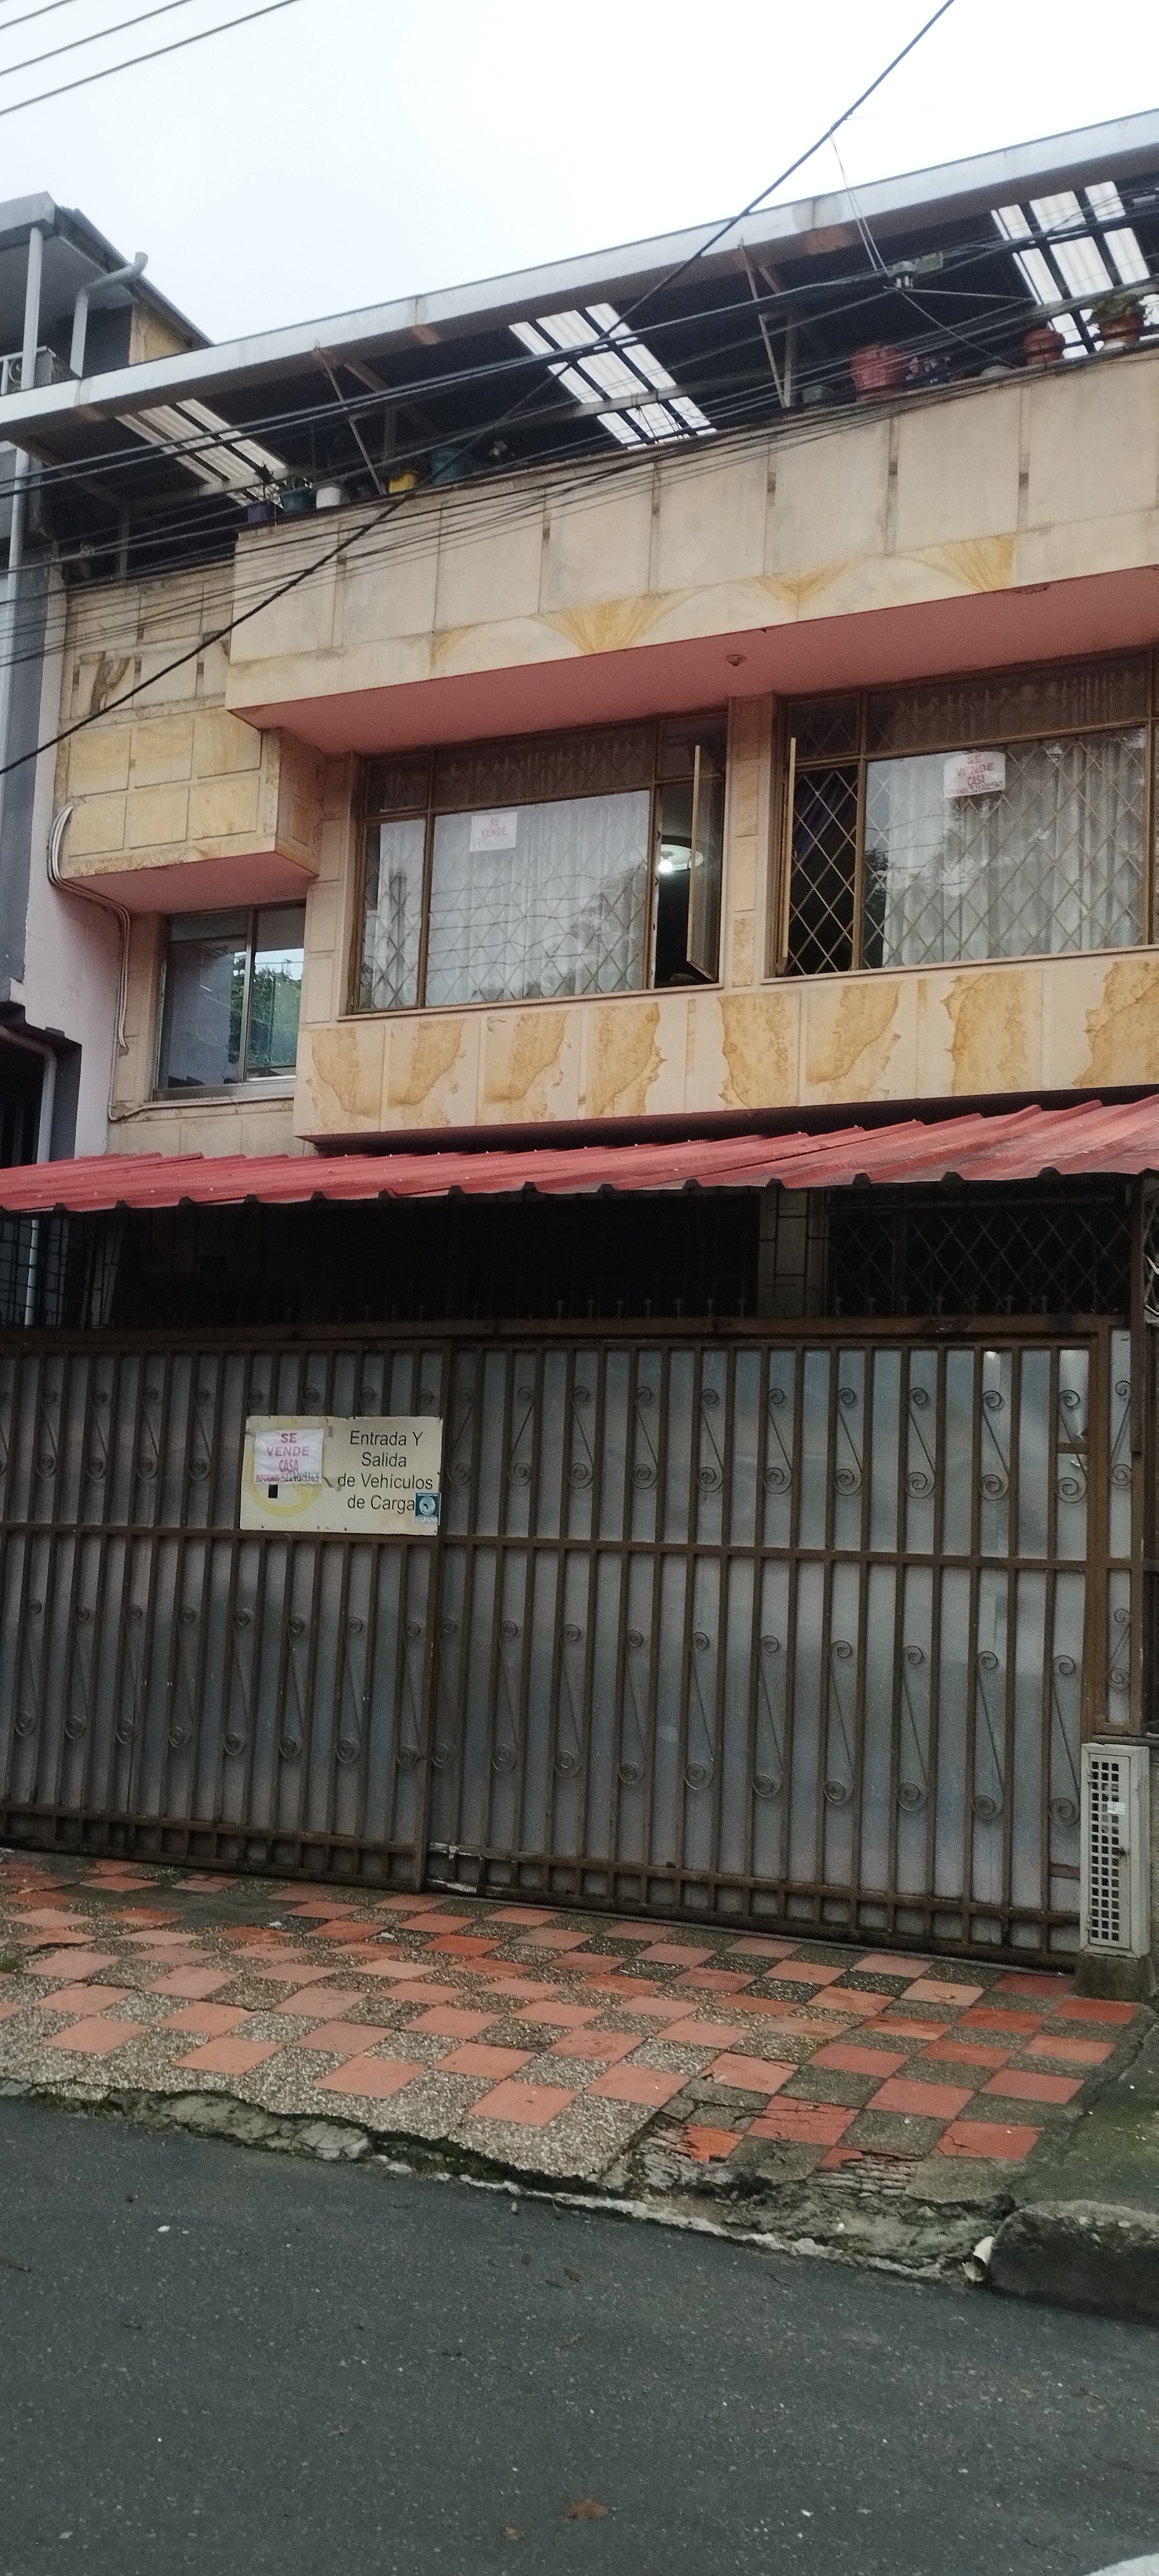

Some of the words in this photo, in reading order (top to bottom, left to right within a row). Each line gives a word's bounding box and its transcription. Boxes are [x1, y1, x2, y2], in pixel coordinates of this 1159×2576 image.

[967, 774, 985, 787] CASA
[489, 818, 500, 827] SE
[480, 826, 508, 838] VENDE
[280, 1433, 297, 1443] SE
[350, 1430, 407, 1445] Entrada
[412, 1431, 424, 1445] Y
[266, 1446, 310, 1457] VENDE
[278, 1458, 299, 1472] CASA
[362, 1452, 407, 1467] Salida
[338, 1472, 355, 1487] de
[348, 1494, 365, 1509] de
[371, 1494, 415, 1514] Carga
